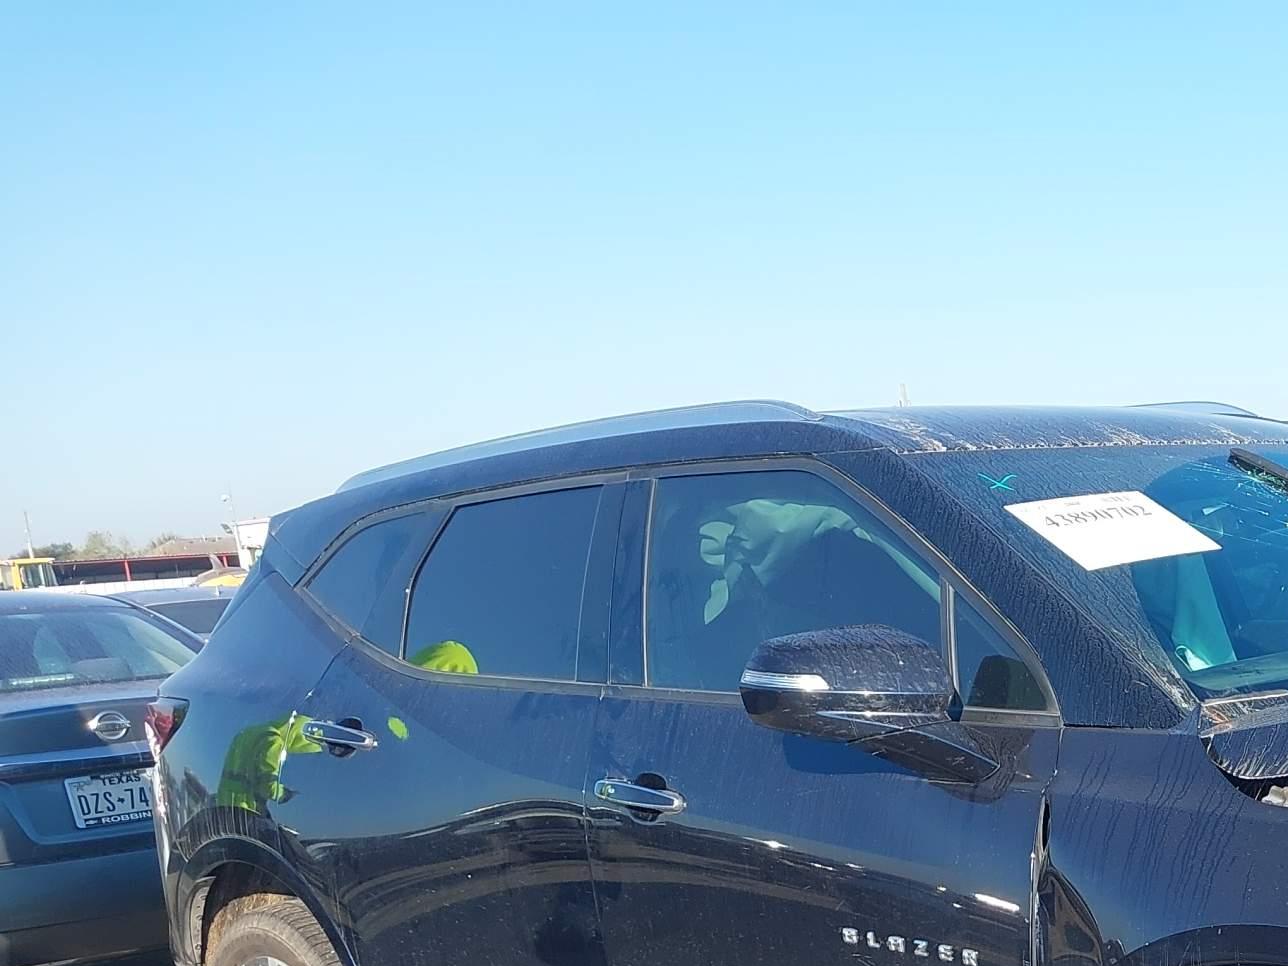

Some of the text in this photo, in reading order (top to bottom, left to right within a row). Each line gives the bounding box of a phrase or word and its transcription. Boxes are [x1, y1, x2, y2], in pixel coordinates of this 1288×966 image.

[1044, 504, 1153, 528] 43890702
[102, 774, 142, 787] TEXAS
[841, 926, 979, 966] BLAZER
